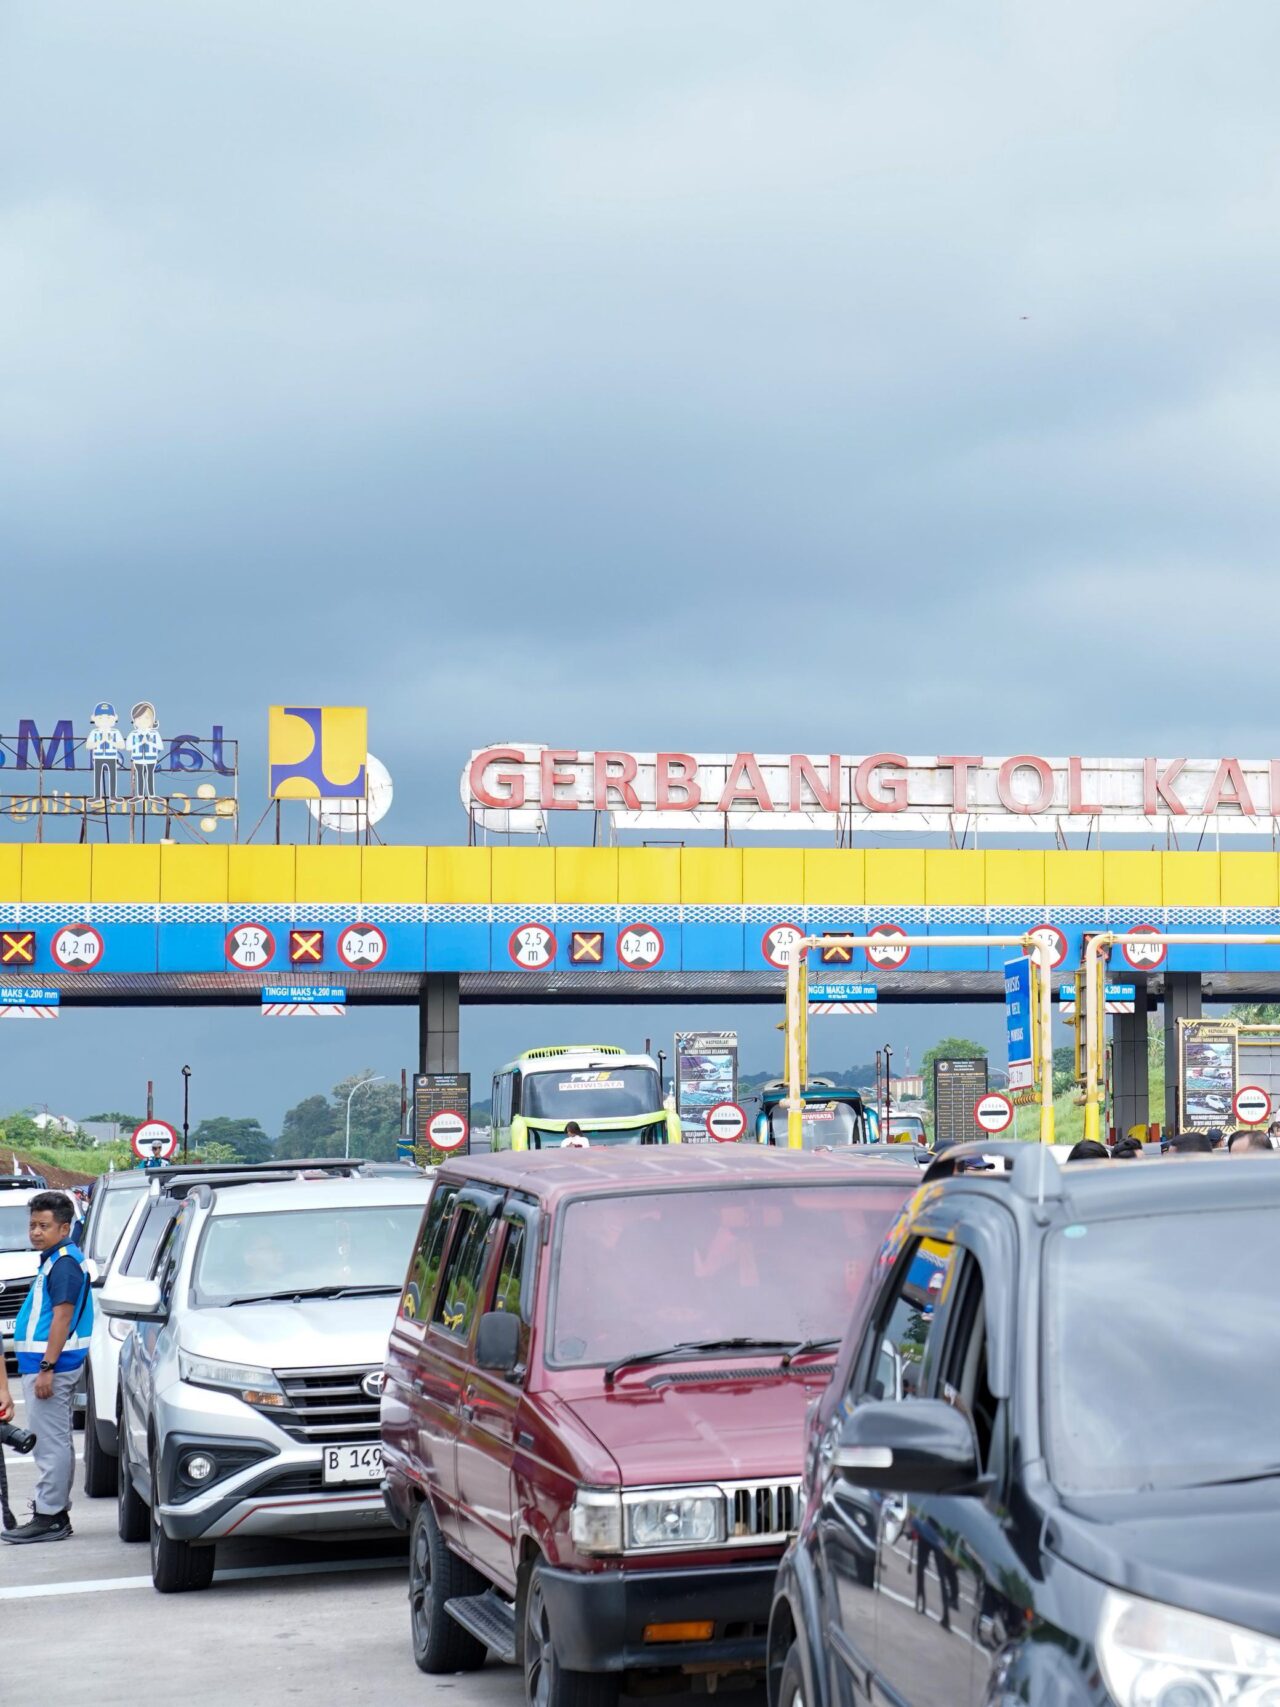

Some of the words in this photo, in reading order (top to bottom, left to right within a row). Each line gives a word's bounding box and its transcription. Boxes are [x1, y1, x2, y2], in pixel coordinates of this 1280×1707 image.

[469, 748, 909, 813] GERBANG
[936, 755, 1102, 815] TOL
[242, 932, 260, 947] 2,5
[525, 932, 542, 948] 2,5
[777, 931, 794, 946] 2,5
[60, 940, 79, 956] 4,2
[84, 943, 95, 954] m
[345, 940, 364, 955] 4,2
[368, 942, 379, 953] m
[623, 940, 641, 954] 4,2
[646, 941, 657, 953] m
[245, 951, 256, 962] m
[528, 950, 539, 961] m
[1, 988, 23, 998] MAKS
[24, 989, 44, 999] 4.200
[45, 991, 58, 999] mm
[265, 987, 289, 996] TINGGI
[290, 988, 311, 997] MAKS
[312, 988, 330, 997] 4.200
[331, 989, 344, 997] mm
[808, 985, 825, 994] NGGI
[826, 986, 845, 994] MAKS
[846, 986, 863, 994] 4.200
[329, 1451, 339, 1470] B
[350, 1448, 382, 1468] 149
